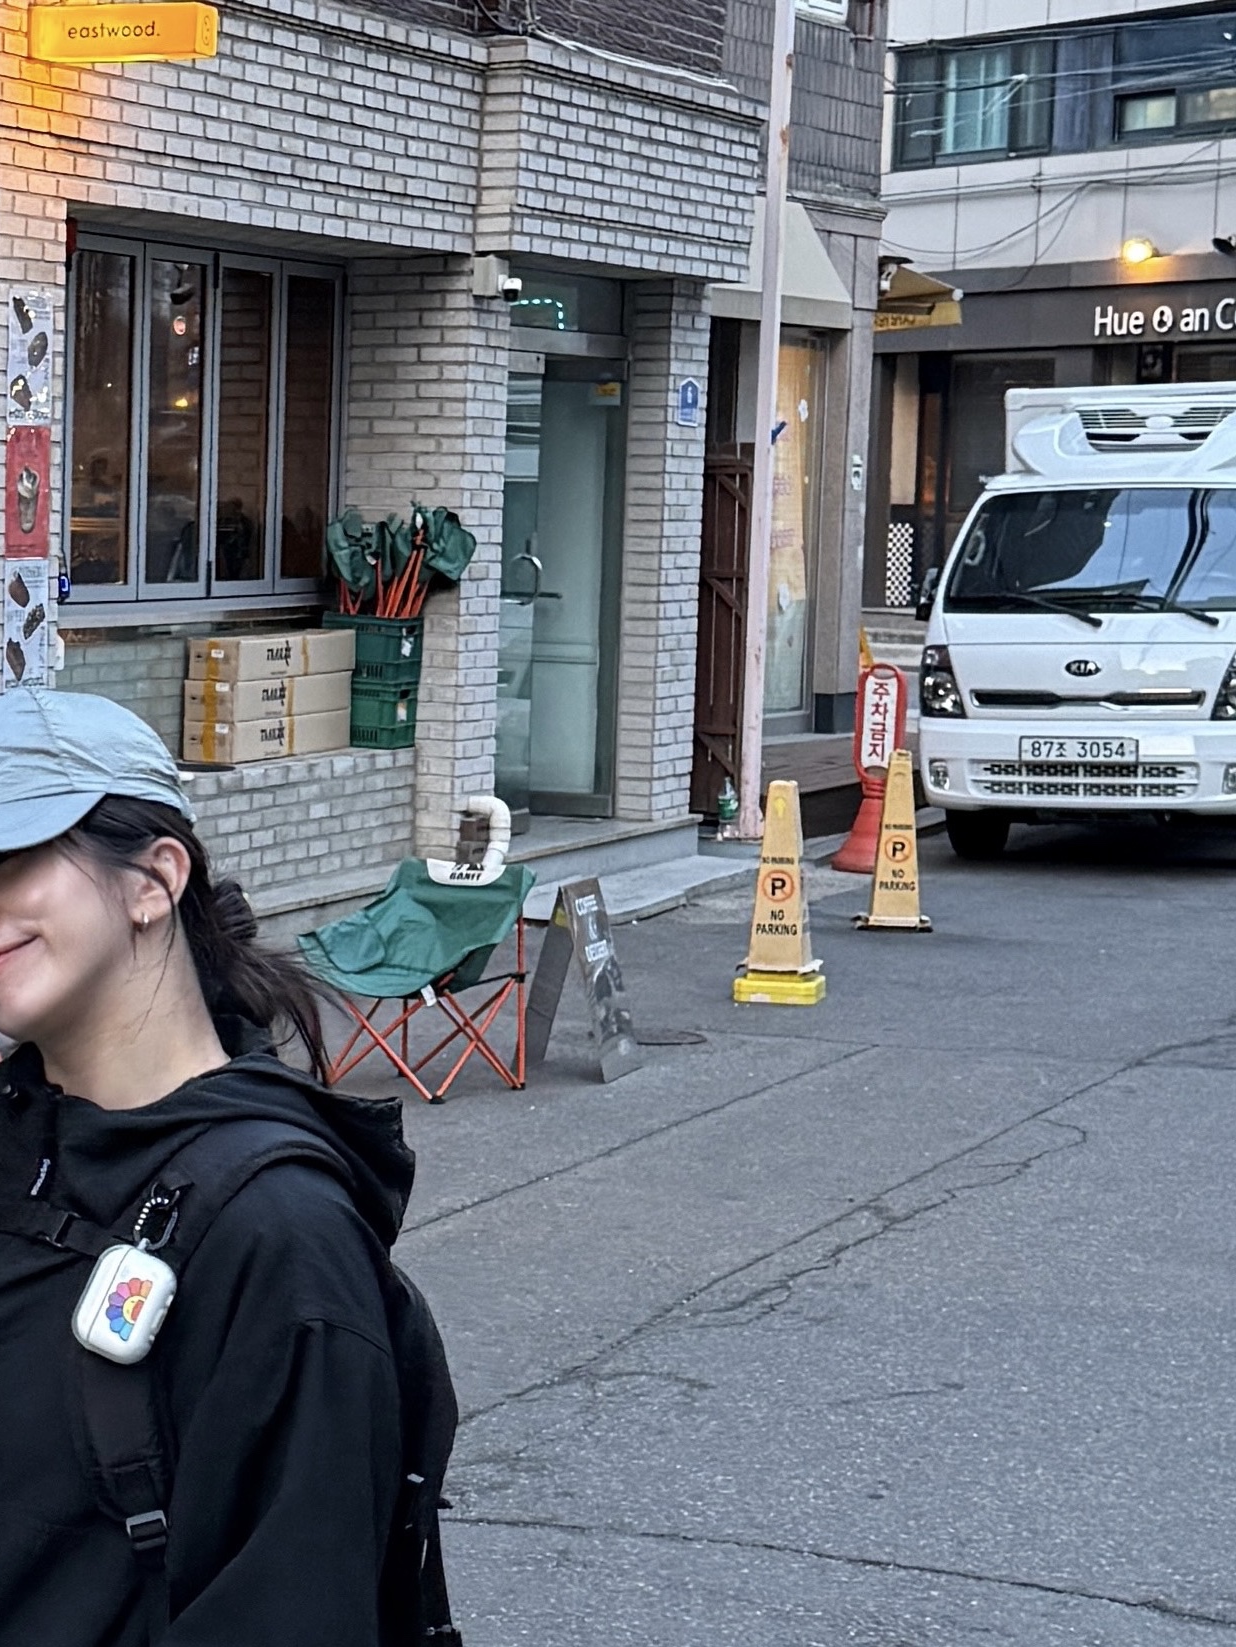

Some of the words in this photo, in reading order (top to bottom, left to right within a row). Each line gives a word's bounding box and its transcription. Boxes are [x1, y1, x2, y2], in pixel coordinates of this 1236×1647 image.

[67, 20, 161, 39] eastwood.
[1094, 305, 1145, 337] Hue
[1179, 307, 1210, 333] an
[1069, 661, 1097, 675] KIA
[867, 681, 891, 762] 주차금지
[1030, 740, 1068, 759] 87조
[1076, 741, 1127, 759] 3054
[891, 868, 905, 880] NO
[879, 880, 916, 893] PARKING
[769, 909, 785, 921] NO
[755, 922, 798, 937] PARKING
